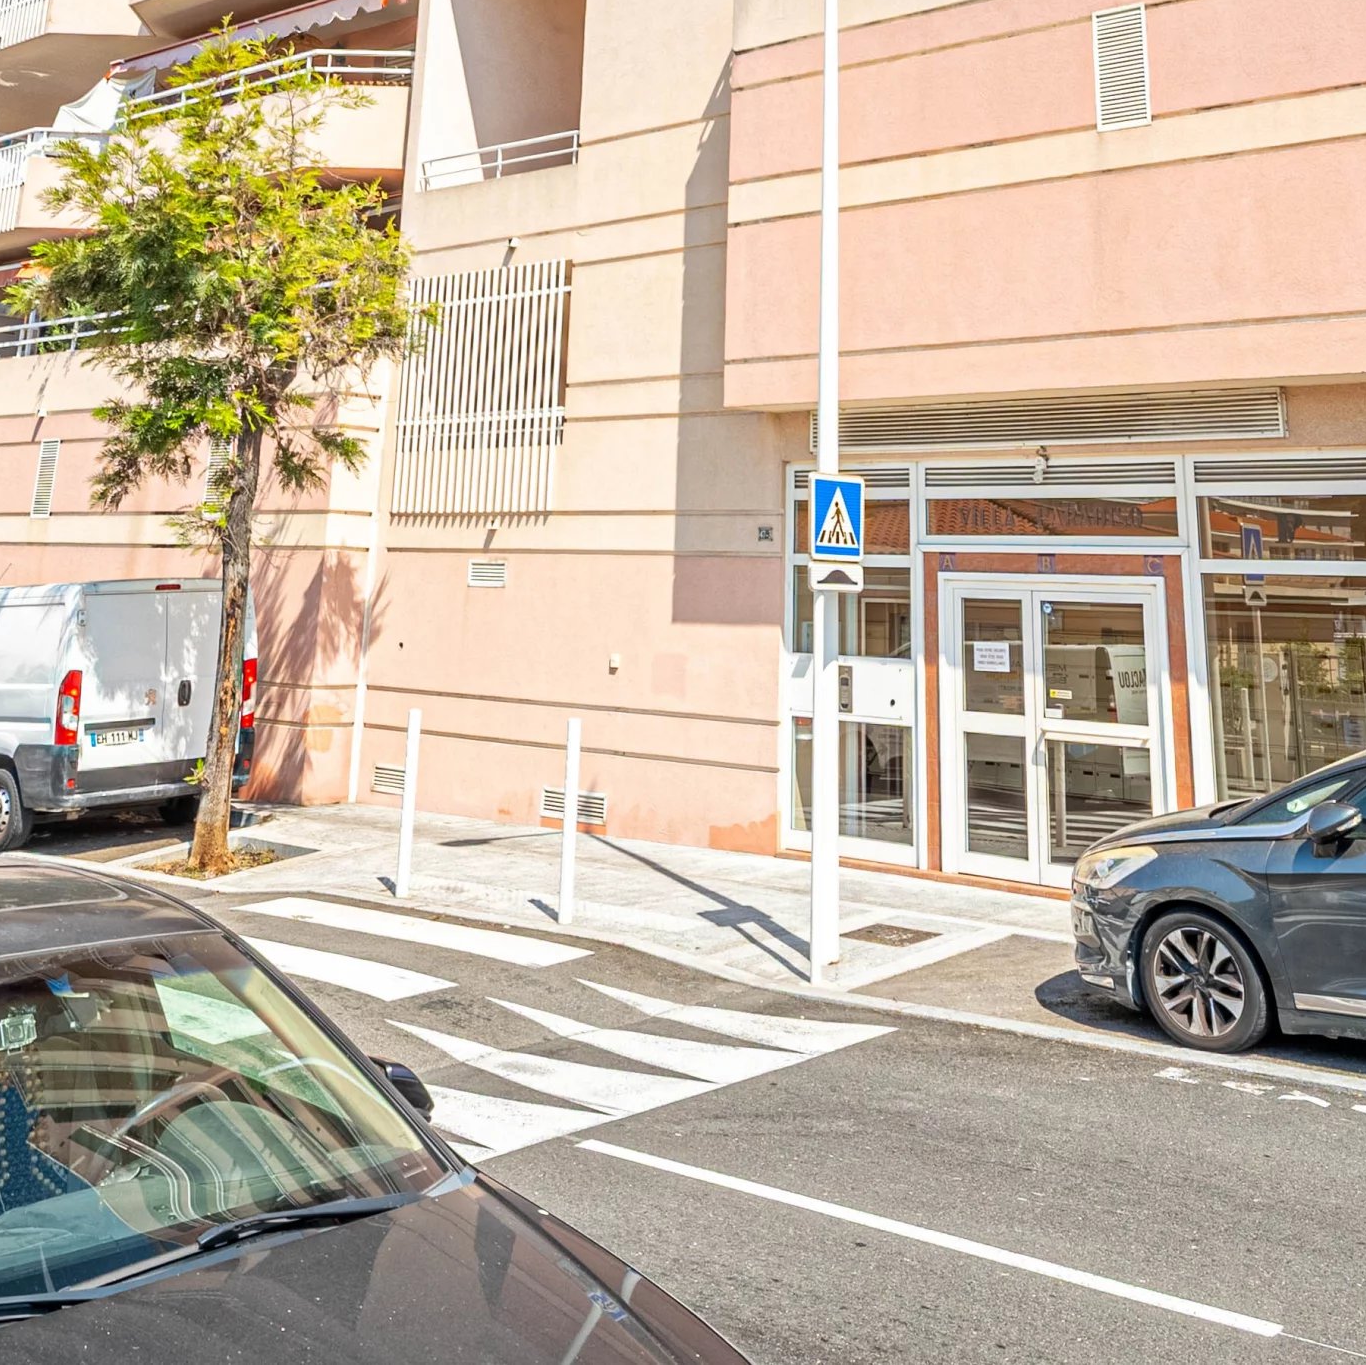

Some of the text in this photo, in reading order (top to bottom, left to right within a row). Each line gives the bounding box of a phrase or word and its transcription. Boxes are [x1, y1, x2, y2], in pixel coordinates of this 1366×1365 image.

[960, 507, 1016, 527] VILLA
[942, 554, 954, 570] A
[1041, 557, 1052, 571] B
[1146, 558, 1162, 573] C
